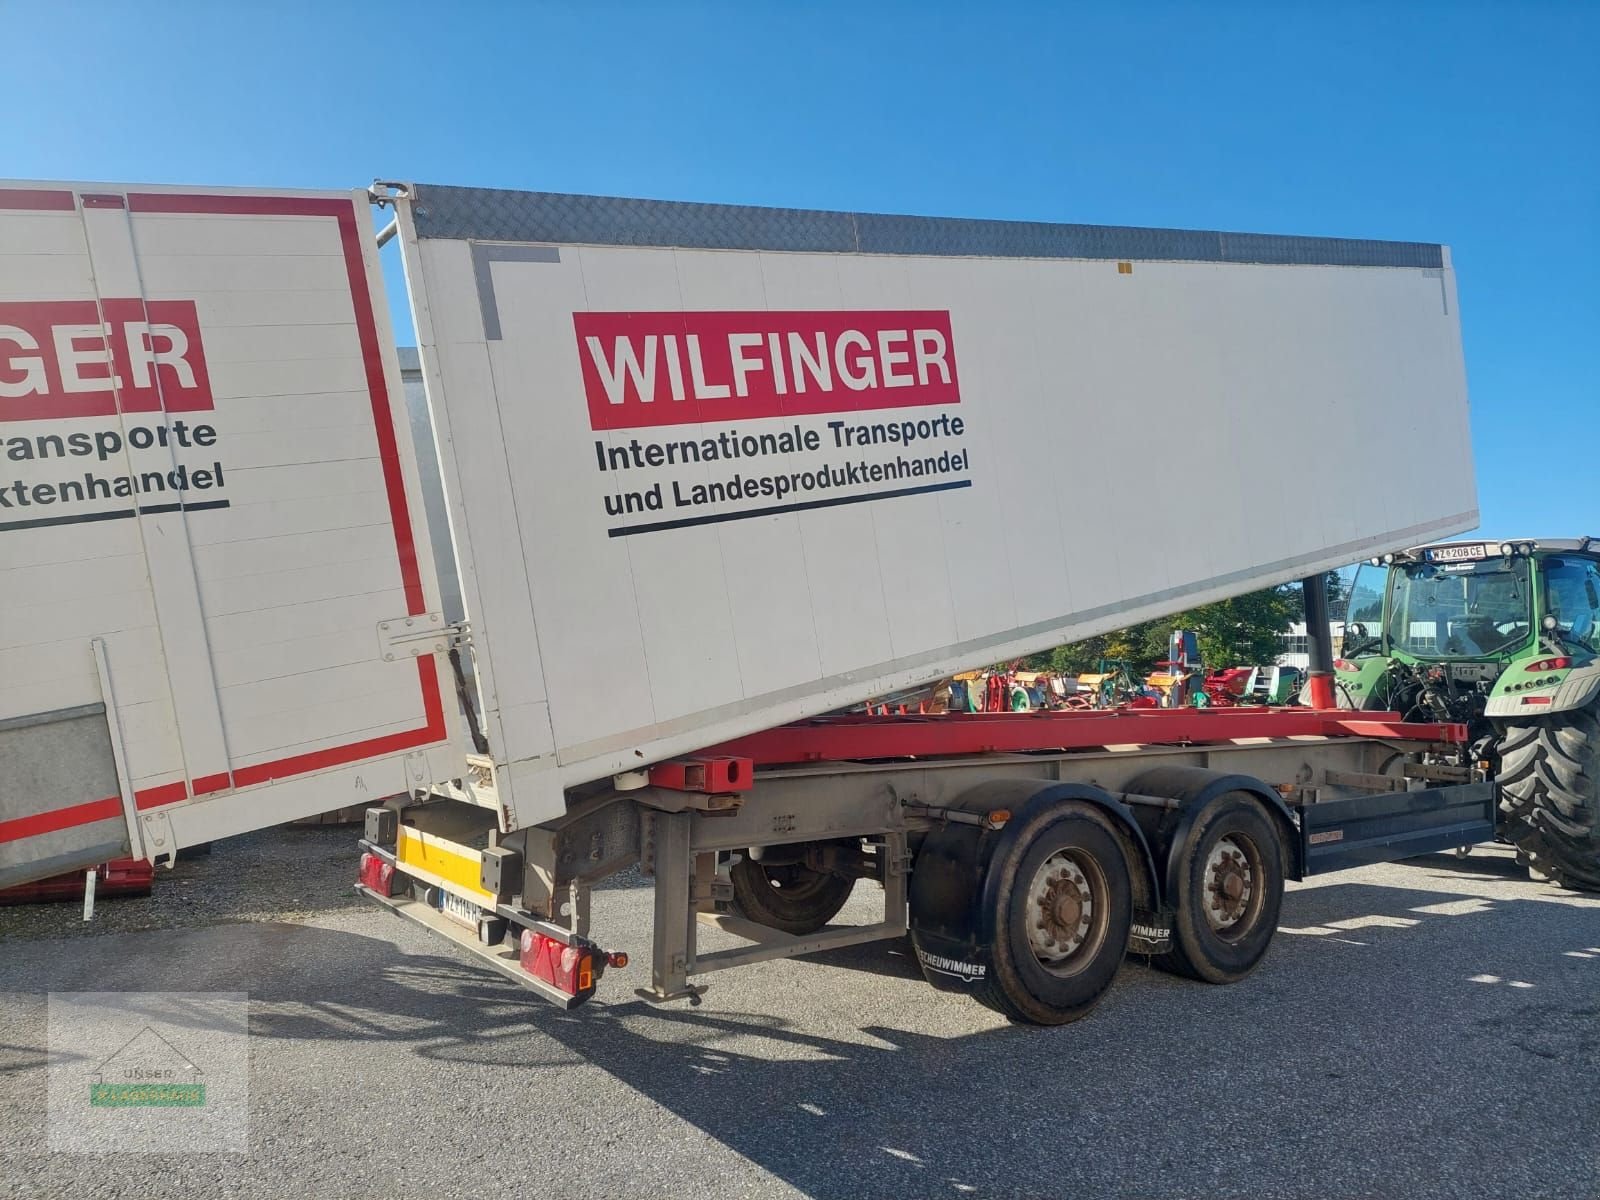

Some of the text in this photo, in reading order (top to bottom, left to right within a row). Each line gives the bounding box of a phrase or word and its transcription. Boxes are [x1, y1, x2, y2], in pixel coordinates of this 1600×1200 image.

[585, 328, 952, 405] WILFINGER
[0, 420, 217, 461] ansporte
[595, 413, 965, 471] Internationale Transporte
[604, 448, 970, 516] und Landesproduktenhandel
[1451, 548, 1469, 558] 208
[1470, 547, 1483, 556] CE
[920, 949, 986, 976] SCHEUWIMMER
